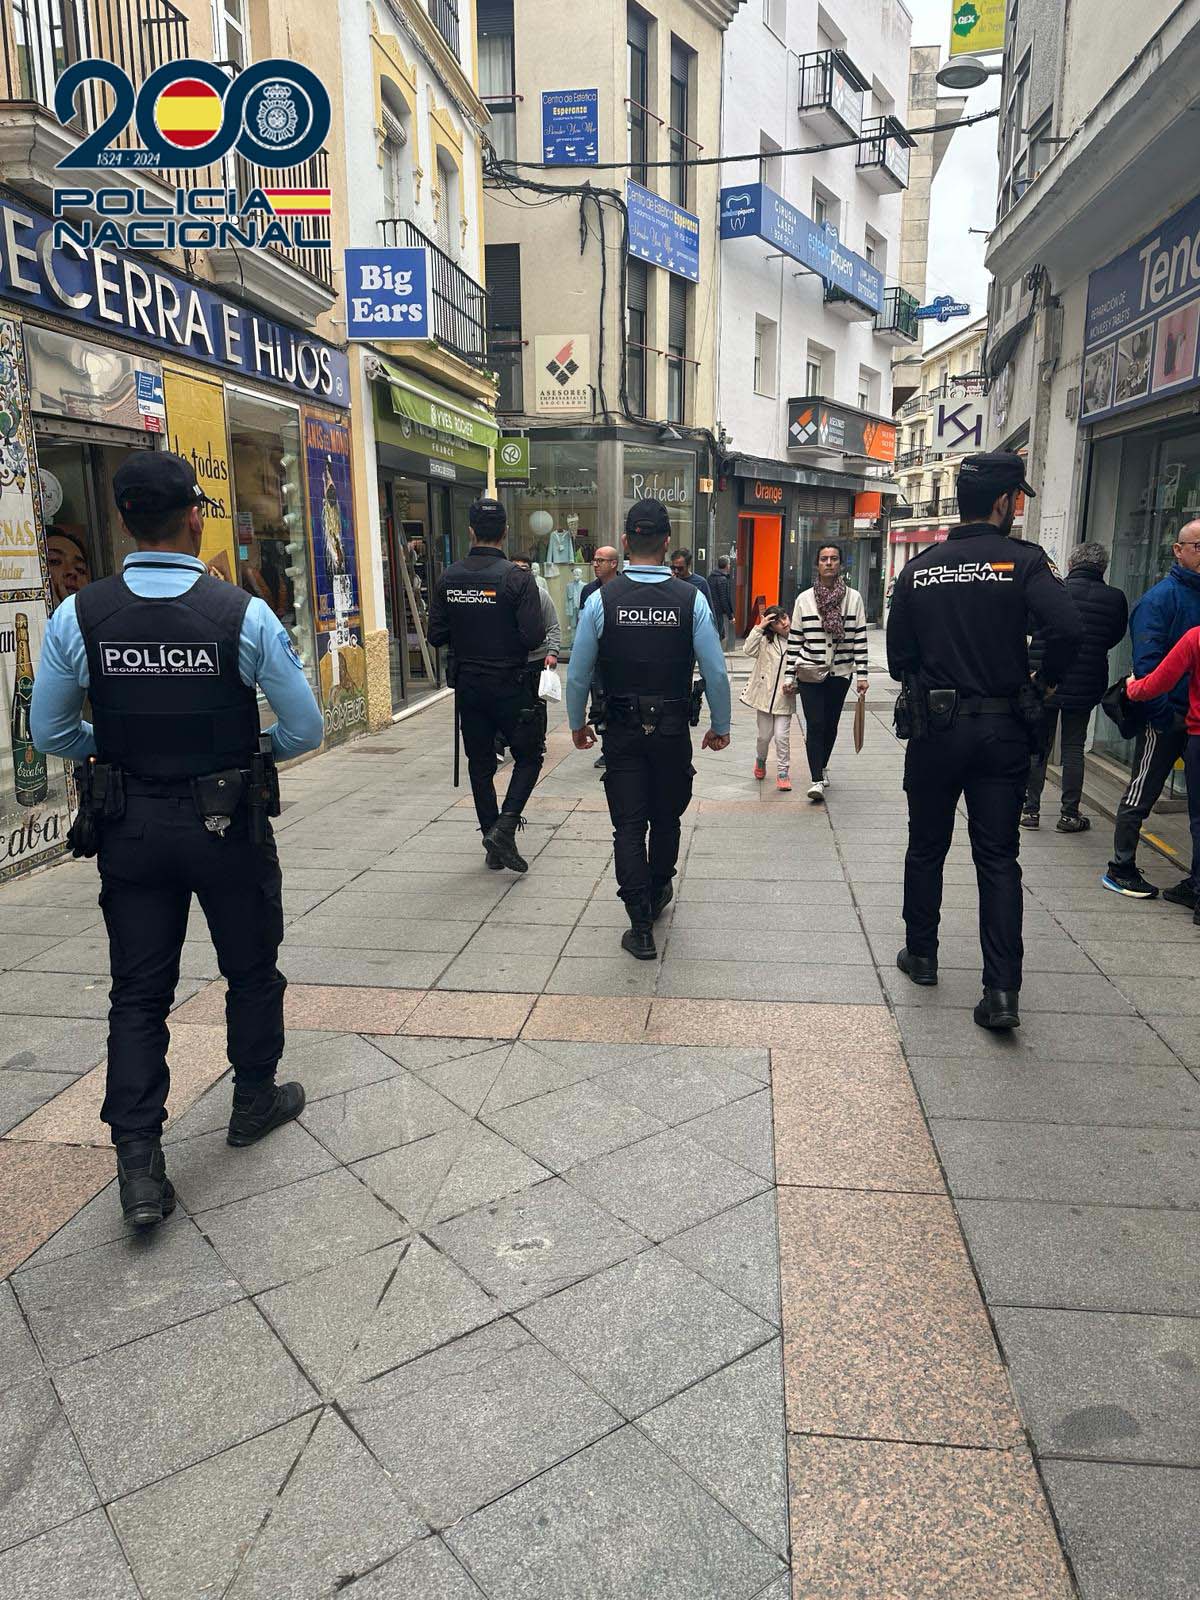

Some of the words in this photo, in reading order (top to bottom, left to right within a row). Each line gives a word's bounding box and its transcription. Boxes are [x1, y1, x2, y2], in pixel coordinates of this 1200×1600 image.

[553, 106, 588, 116] Esperanza
[359, 264, 413, 296] Big
[0, 206, 215, 355] ECERRA
[222, 303, 243, 366] E
[252, 317, 333, 396] HIJOS
[351, 297, 423, 322] Ears
[437, 410, 453, 430] YVES
[454, 416, 474, 437] ROCHER
[192, 441, 228, 481] todas
[631, 473, 687, 503] Rafaello
[755, 481, 783, 504] Orange
[913, 571, 1014, 589] NACIONAL
[447, 596, 497, 604] NACIONAL
[619, 607, 678, 621] POLÍCIA
[104, 645, 215, 668] POLÍCIA
